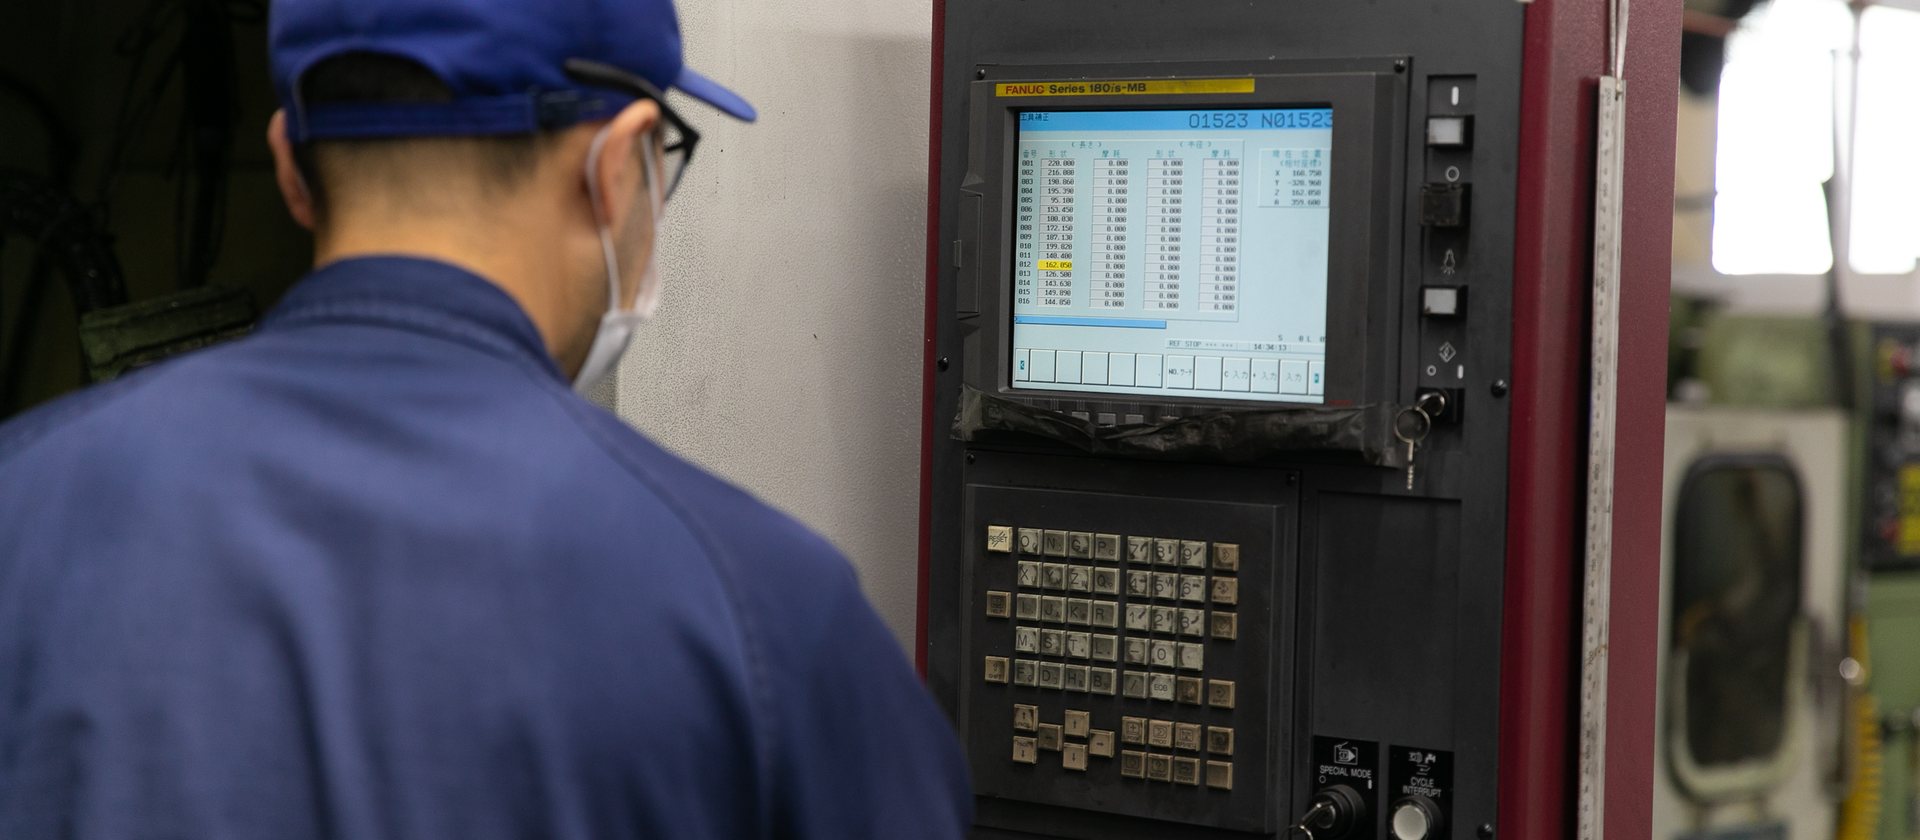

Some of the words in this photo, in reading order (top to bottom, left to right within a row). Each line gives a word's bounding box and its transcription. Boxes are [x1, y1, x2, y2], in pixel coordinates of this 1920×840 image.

[1005, 85, 1045, 95] FANUC
[1049, 84, 1085, 94] Series
[1090, 83, 1146, 93] 180is-MB
[1261, 112, 1333, 128] N01523
[1020, 535, 1029, 548] O
[1046, 537, 1056, 550] N
[1071, 539, 1081, 552] G
[1097, 541, 1106, 553] P
[1183, 548, 1192, 560] 9
[1020, 569, 1029, 581] X
[1046, 570, 1054, 582] Y
[1071, 572, 1079, 585] Z
[1097, 574, 1106, 588] Q
[1155, 580, 1164, 593] 5
[1182, 582, 1191, 595] 6
[1045, 604, 1053, 616] J
[1070, 606, 1078, 618] K
[1095, 608, 1104, 620] R
[1154, 613, 1163, 626] 2
[1017, 634, 1027, 646] M
[1044, 636, 1053, 649] S
[1068, 639, 1078, 652] T
[1095, 641, 1102, 654] L
[1016, 666, 1024, 678] F
[1042, 669, 1050, 682] D
[1068, 671, 1077, 683] H
[1093, 675, 1102, 688] B
[1153, 683, 1168, 692] EOB
[1320, 765, 1348, 776] SPECIAL
[1351, 768, 1372, 779] MODE
[1410, 776, 1434, 788] CYCLE
[1402, 785, 1442, 798] INTERRUPT
